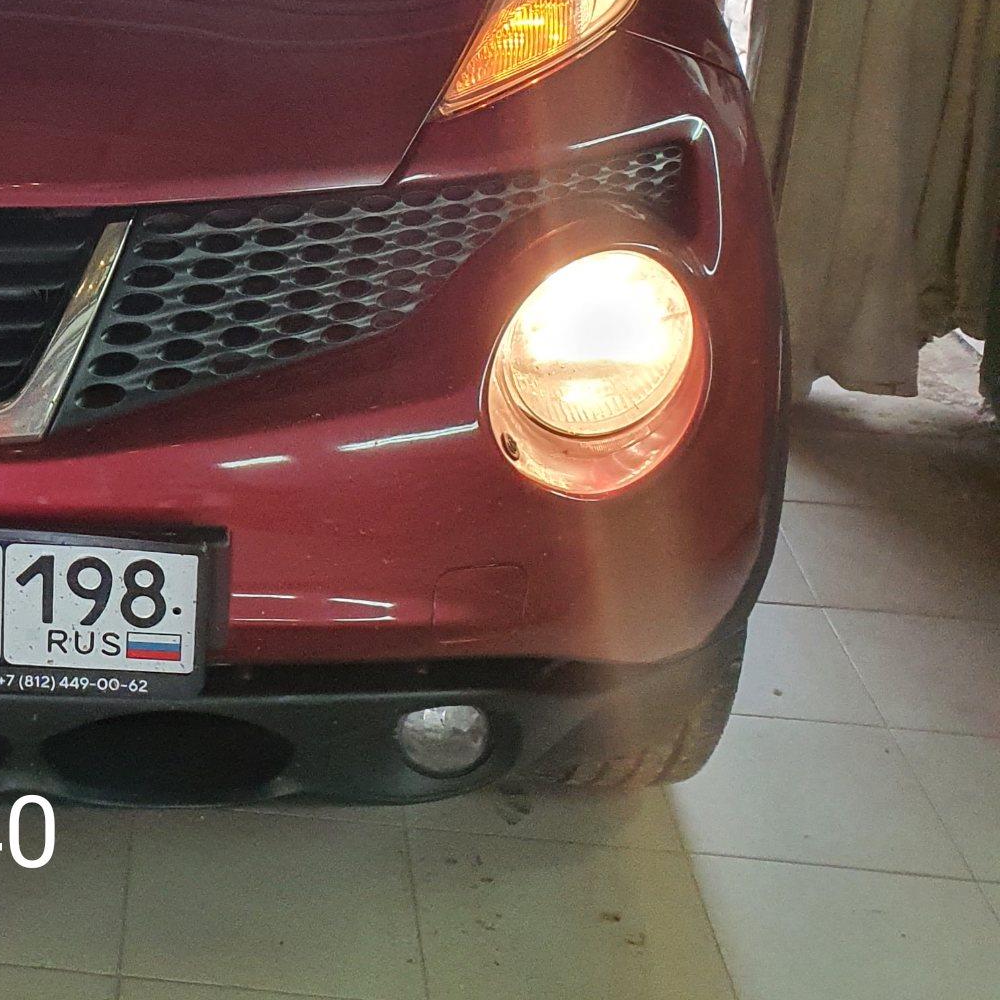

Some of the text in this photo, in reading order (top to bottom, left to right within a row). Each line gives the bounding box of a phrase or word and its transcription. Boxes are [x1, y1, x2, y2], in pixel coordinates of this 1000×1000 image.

[15, 554, 167, 628] 198
[47, 629, 121, 656] RUS
[19, 674, 56, 691] (812)
[59, 676, 149, 693] 449-00-62
